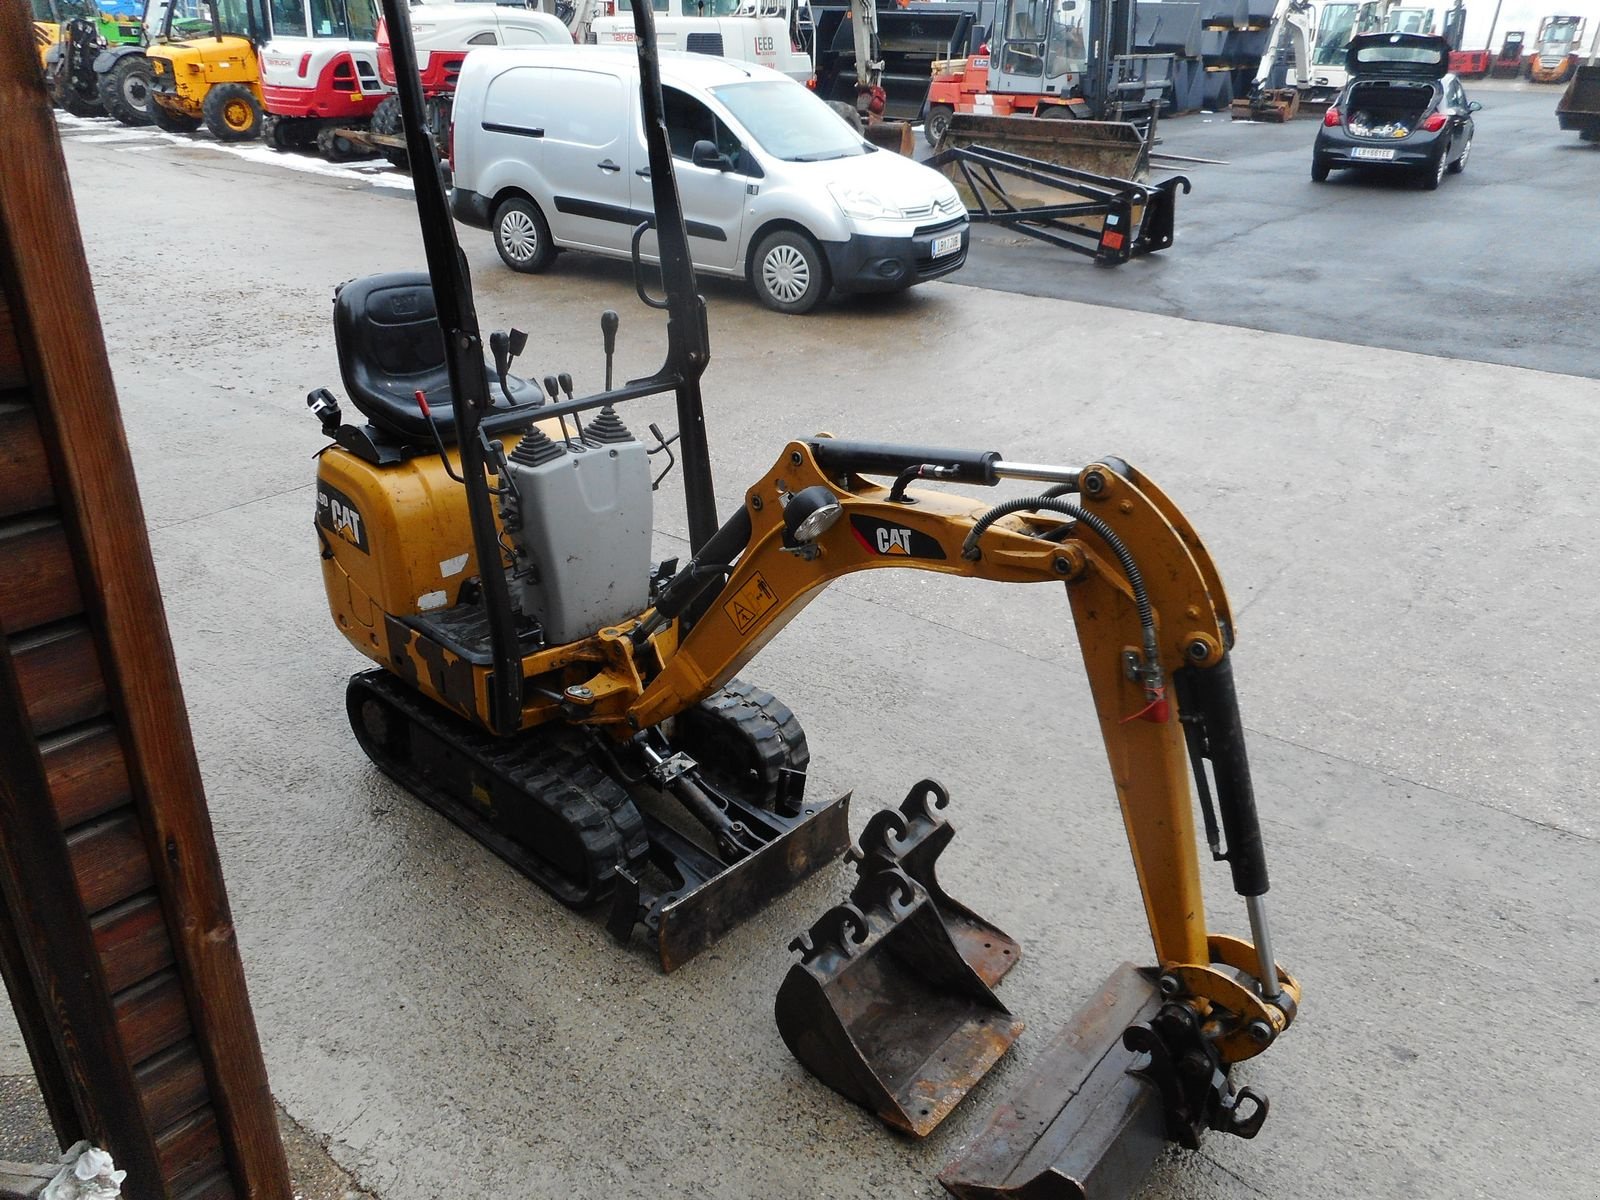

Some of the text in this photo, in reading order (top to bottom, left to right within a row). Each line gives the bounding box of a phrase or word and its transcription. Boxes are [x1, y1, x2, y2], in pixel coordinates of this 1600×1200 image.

[754, 36, 774, 55] LEEB
[331, 499, 360, 545] CAT
[876, 527, 911, 555] CAT
